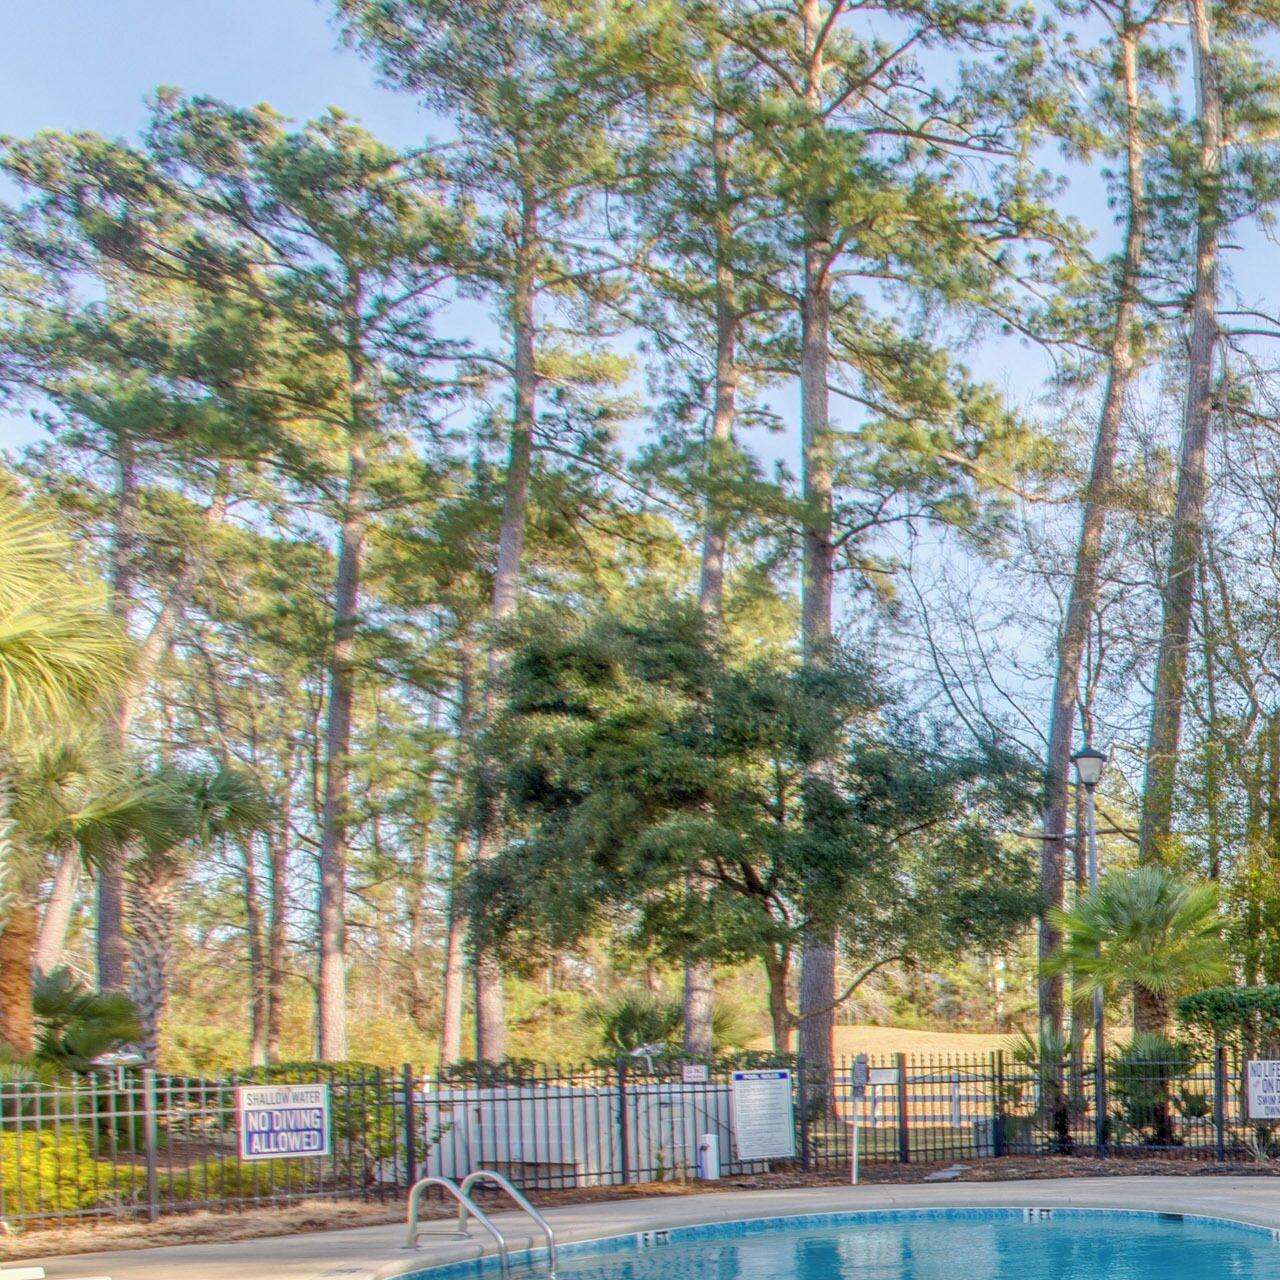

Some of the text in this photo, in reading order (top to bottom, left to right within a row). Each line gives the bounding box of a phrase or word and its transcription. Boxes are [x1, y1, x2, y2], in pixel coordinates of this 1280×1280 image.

[1251, 1062, 1262, 1077] NO
[1262, 1079, 1274, 1093] ON
[247, 1091, 321, 1105] SHALLOW WATER
[1257, 1095, 1276, 1105] SWIM
[1264, 1106, 1280, 1116] OWN
[247, 1109, 322, 1132] NO DIVING
[250, 1131, 320, 1153] ALLOWED
